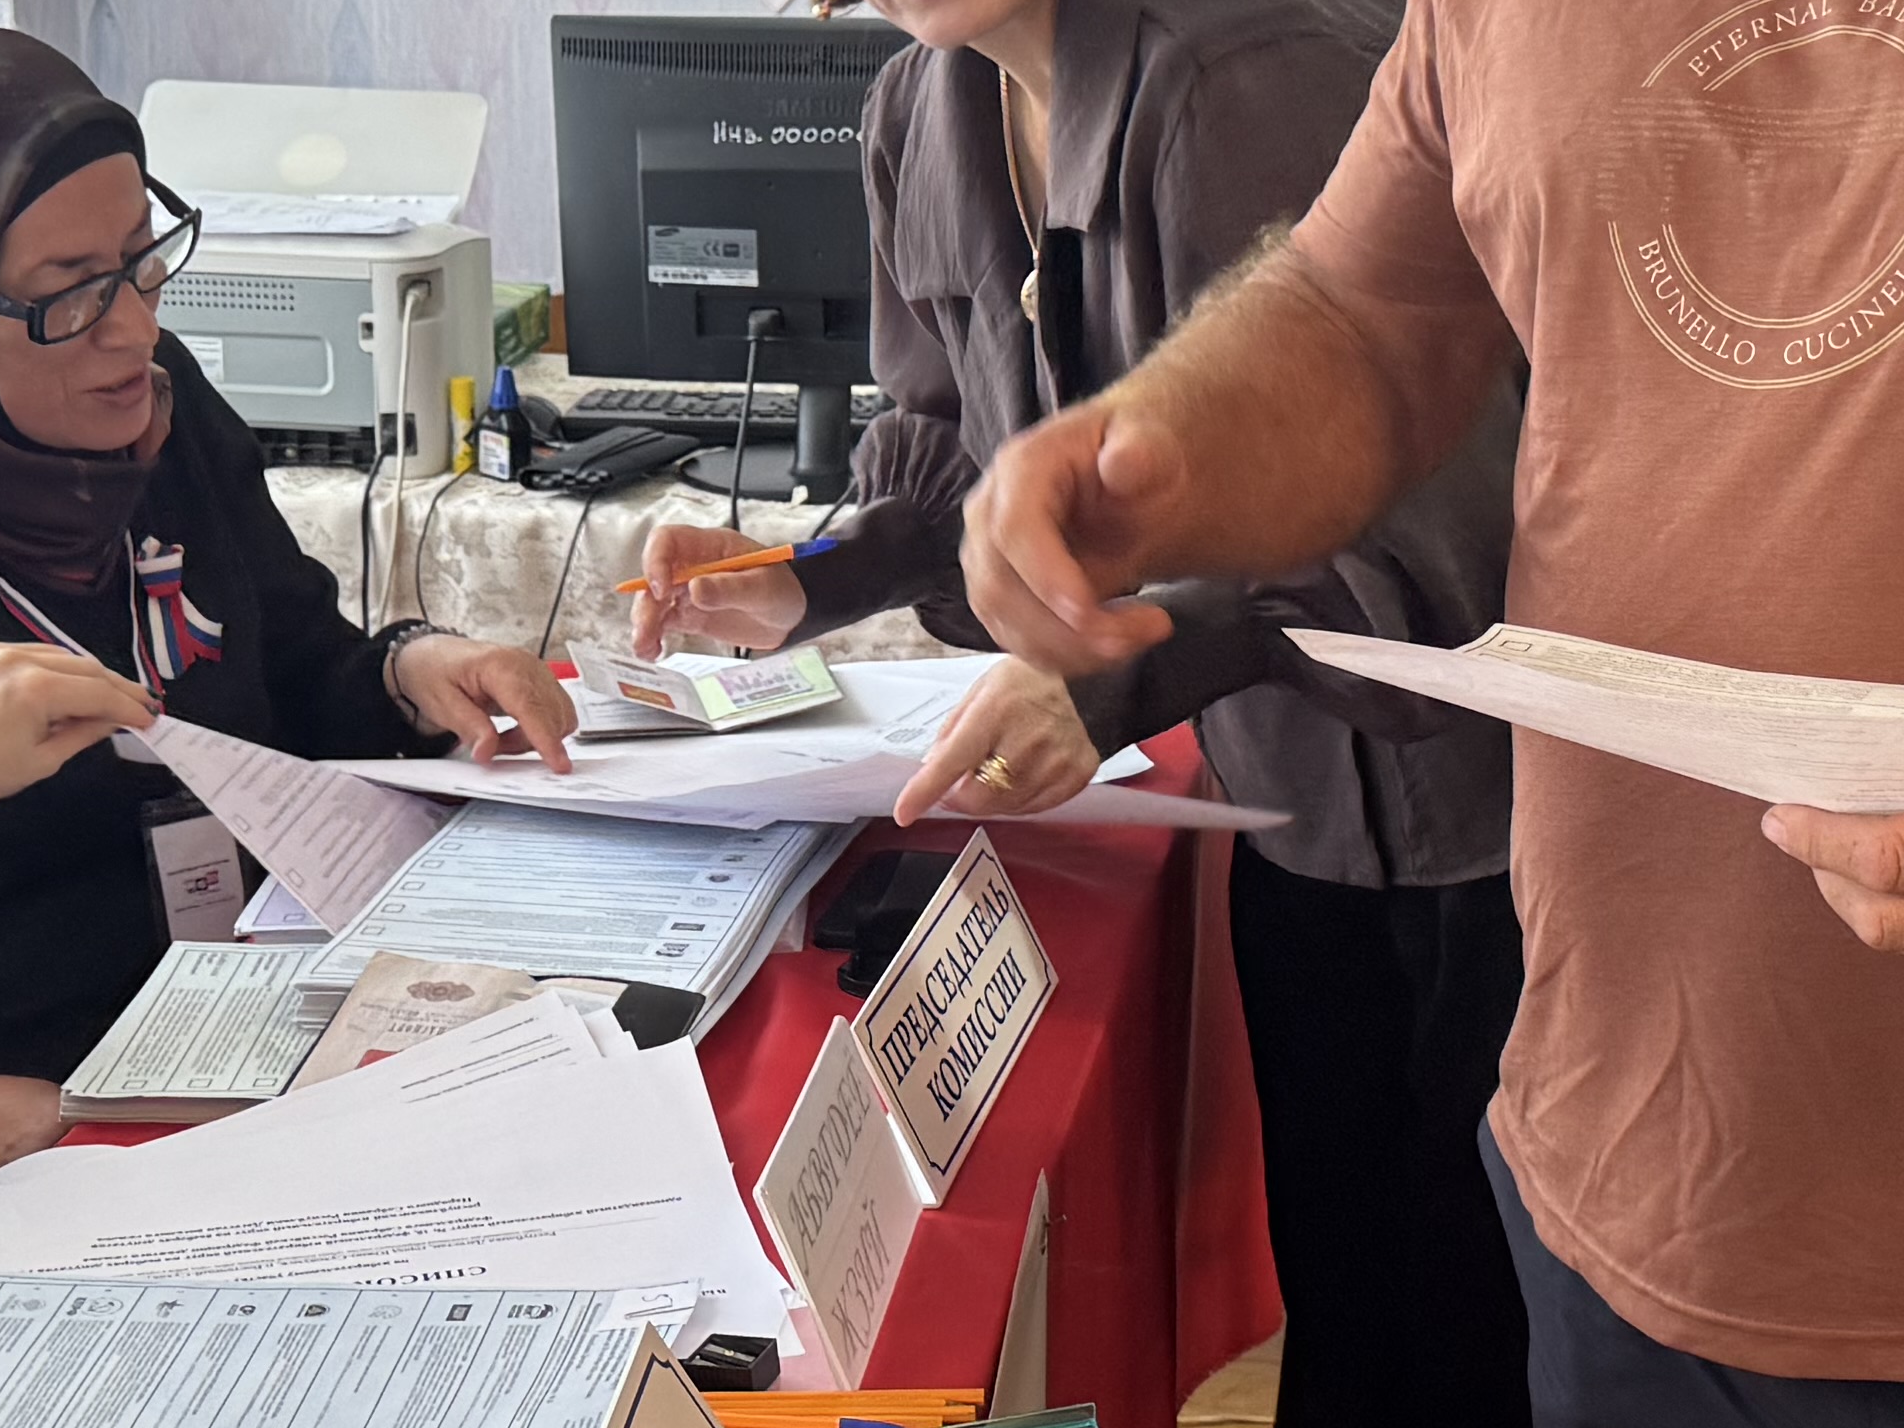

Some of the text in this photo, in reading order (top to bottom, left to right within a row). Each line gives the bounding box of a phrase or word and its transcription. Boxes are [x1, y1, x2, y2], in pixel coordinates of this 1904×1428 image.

[1637, 238, 1757, 365] BRUNELLO
[880, 877, 1011, 1086] ПРЕДСЕДАТЕЛЬ
[925, 947, 1027, 1123] КОМИССИИ
